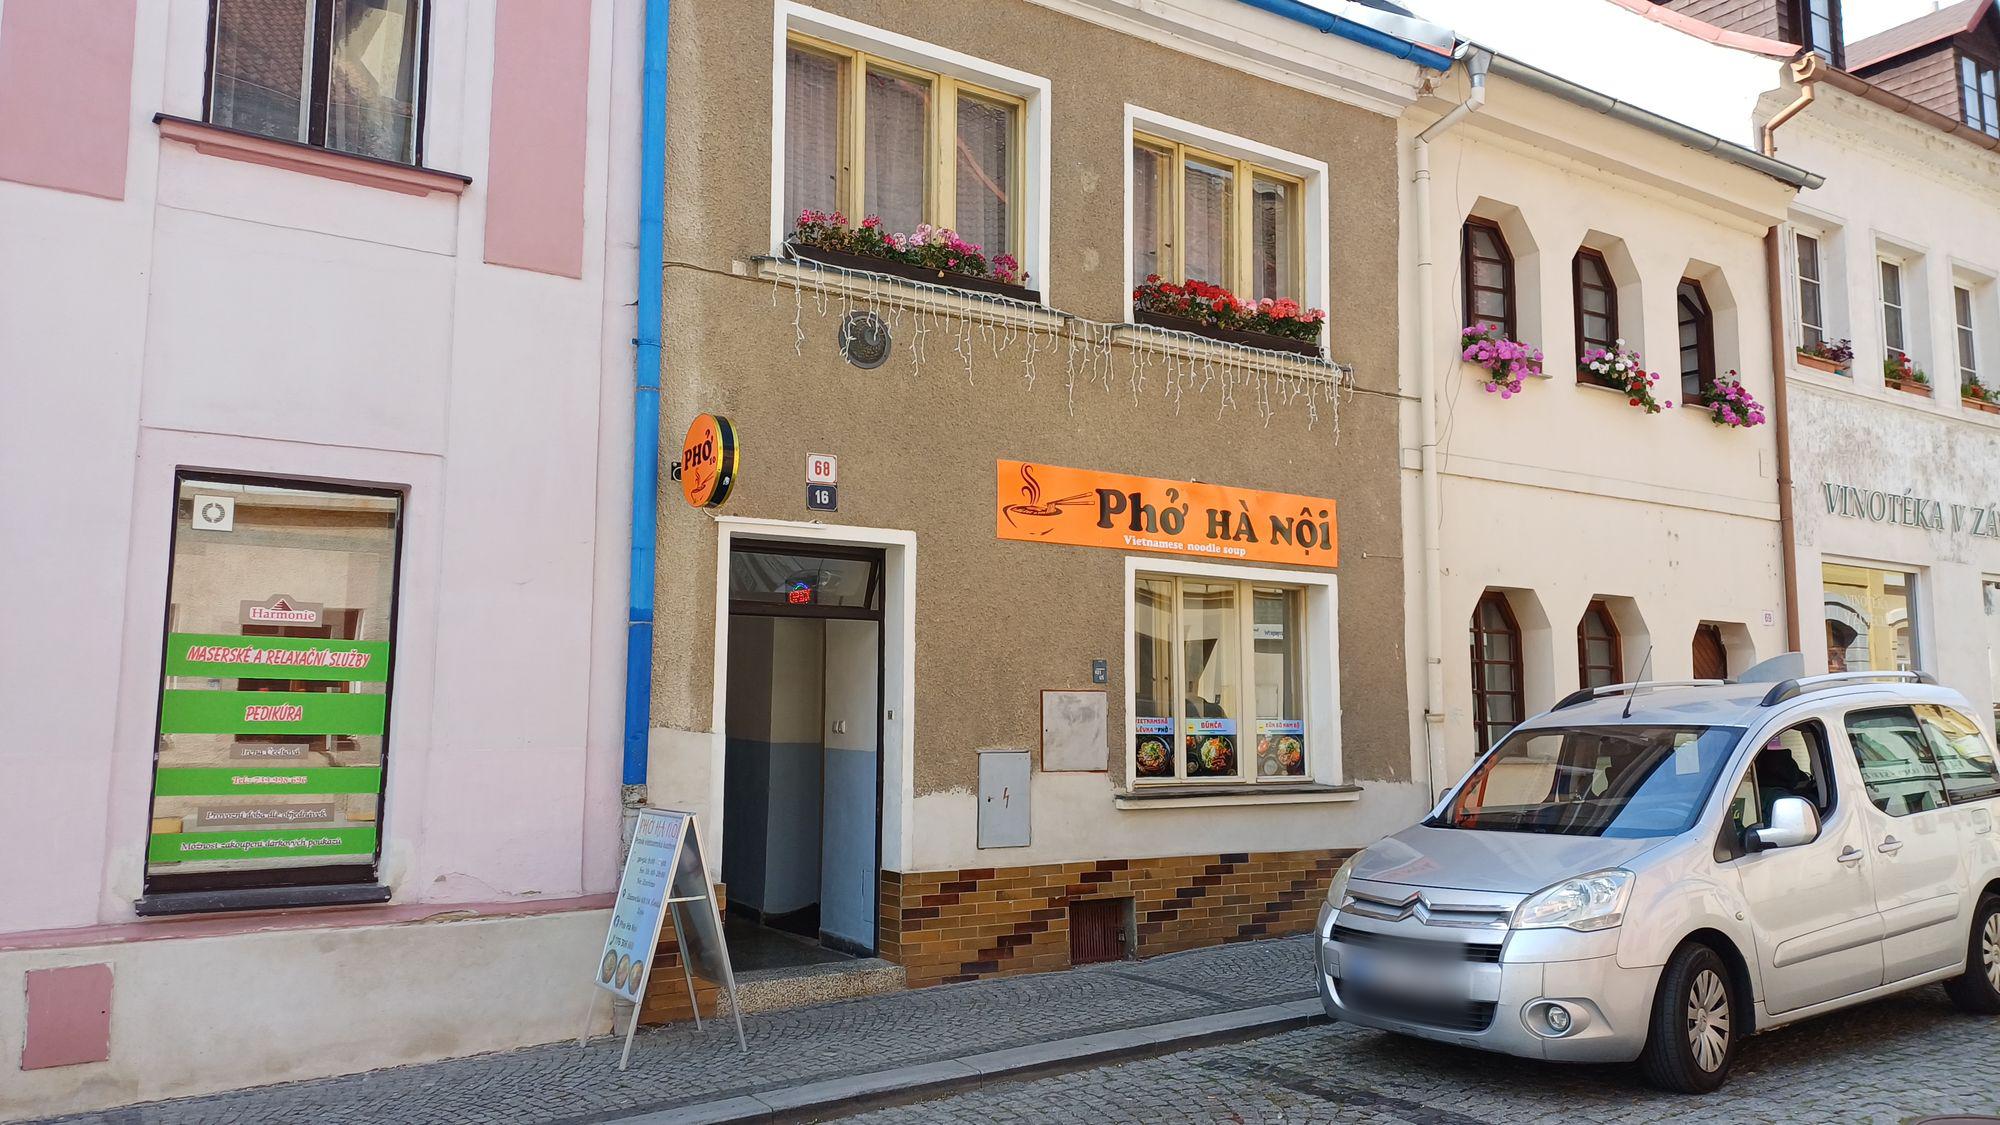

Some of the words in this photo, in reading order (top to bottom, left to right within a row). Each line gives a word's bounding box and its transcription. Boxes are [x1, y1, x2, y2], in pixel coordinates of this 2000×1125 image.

[814, 460, 831, 477] 68
[814, 489, 830, 505] 16
[1095, 487, 1189, 536] Phở
[1206, 500, 1260, 543] HÀ
[1823, 482, 1946, 532] VINOTÉKA
[1951, 503, 1966, 533] V
[1971, 502, 2000, 539] ZÁ
[1123, 534, 1184, 551] Vietnamese
[1187, 542, 1222, 554] noodle
[1223, 546, 1248, 557] soup
[251, 608, 316, 622] Harmonie
[187, 645, 253, 663] MASERSKÉ
[252, 650, 263, 664] A
[265, 648, 328, 667] RELAXAČNÍ
[328, 650, 371, 669] SLUŽBY
[245, 702, 303, 721] PEDIKÚRA
